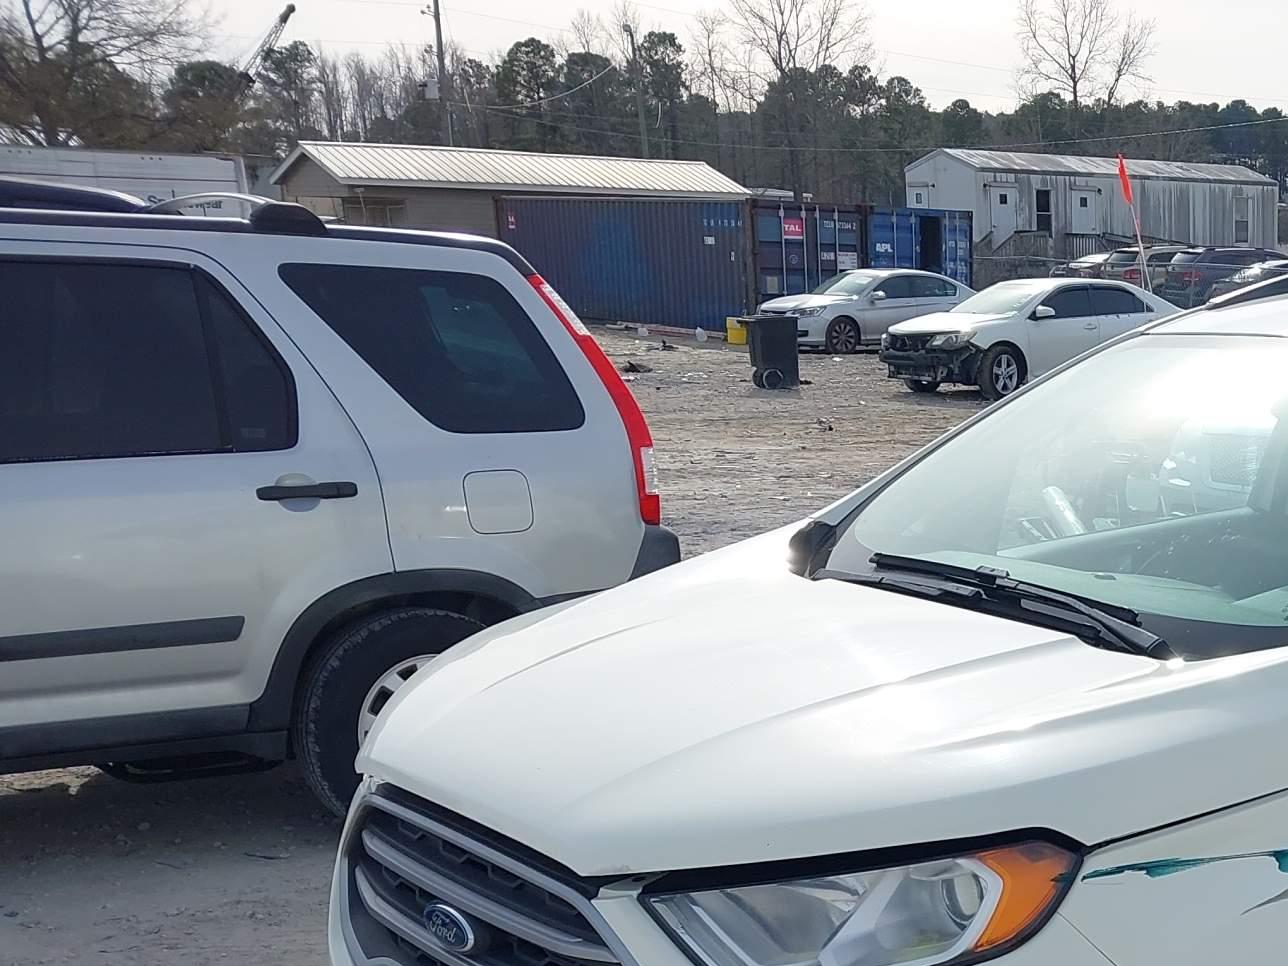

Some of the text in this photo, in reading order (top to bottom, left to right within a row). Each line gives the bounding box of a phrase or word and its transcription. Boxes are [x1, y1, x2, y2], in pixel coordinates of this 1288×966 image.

[784, 224, 802, 232] TAL
[876, 243, 893, 252] APL
[430, 911, 457, 943] Ford
